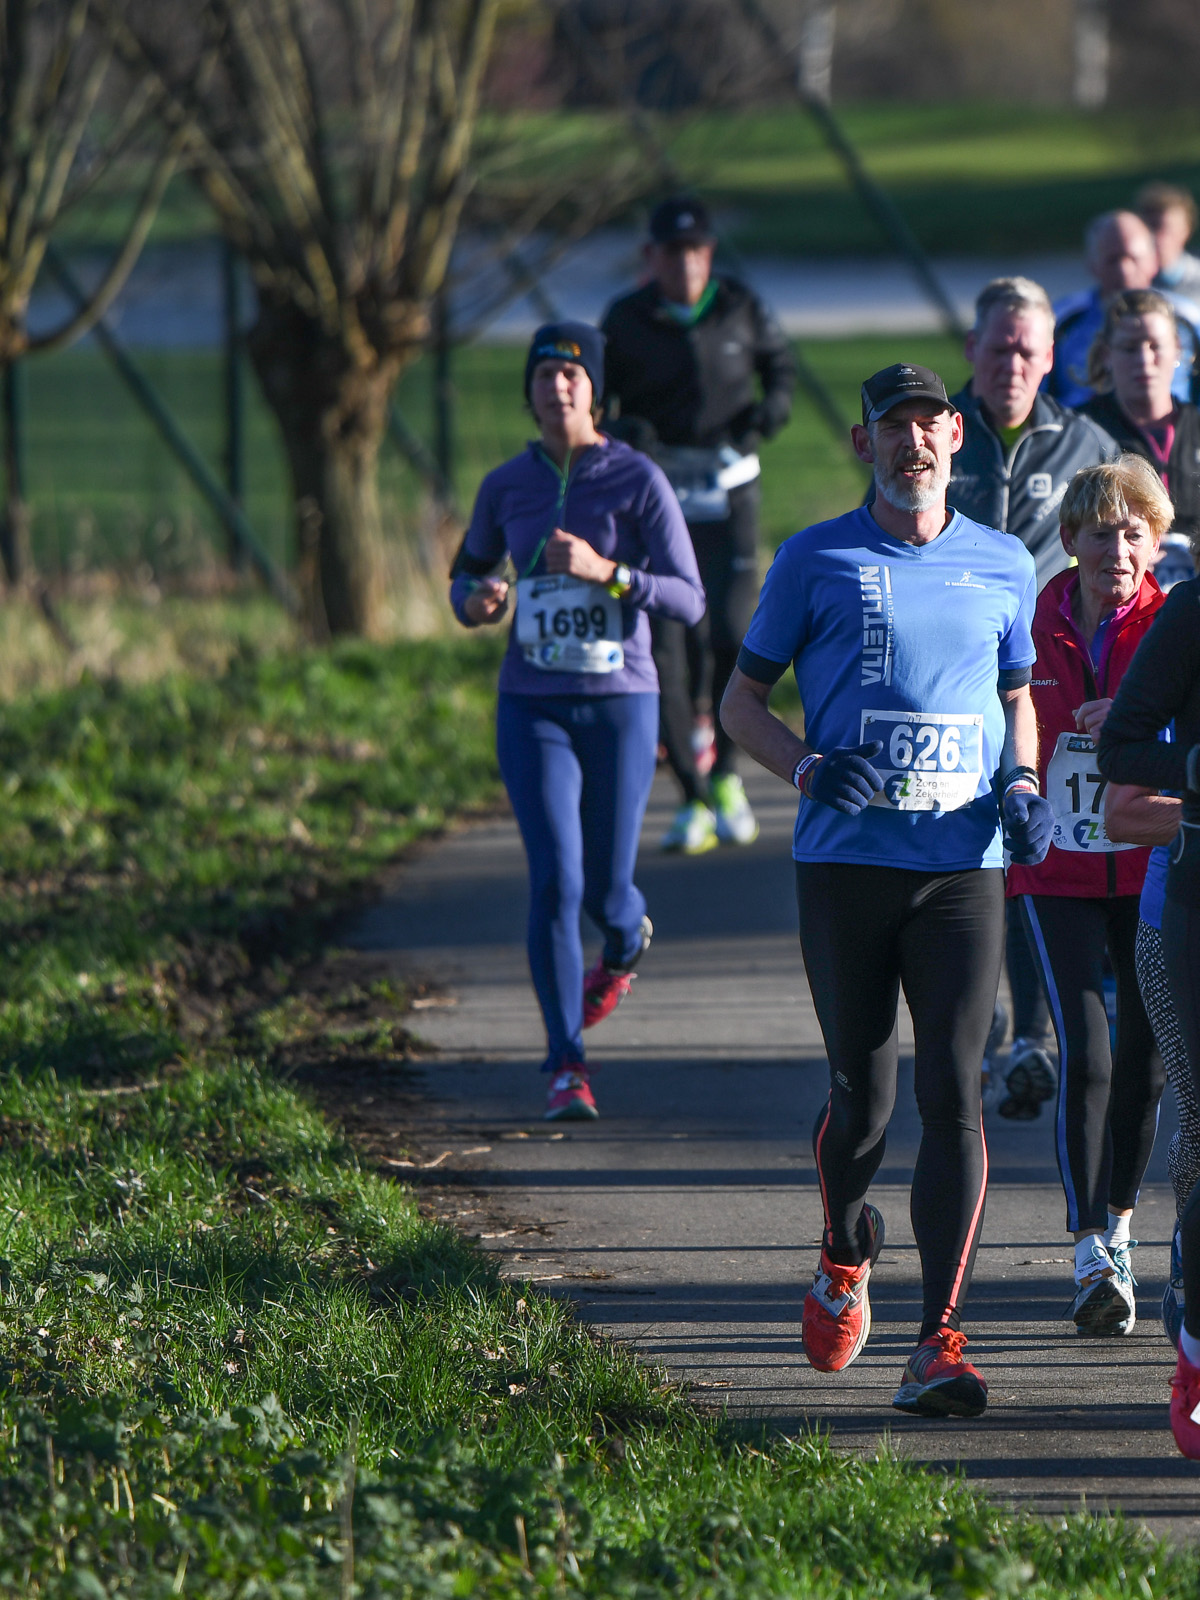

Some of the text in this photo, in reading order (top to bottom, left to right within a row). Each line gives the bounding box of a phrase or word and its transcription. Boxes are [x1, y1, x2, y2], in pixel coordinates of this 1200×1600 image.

[534, 605, 607, 638] 1699
[859, 565, 884, 687] VLIETLIJN
[889, 724, 961, 771] 626
[915, 778, 937, 789] Zorg
[915, 788, 958, 799] Zekerheid
[1065, 772, 1109, 814] 17
[1053, 825, 1062, 836] 3
